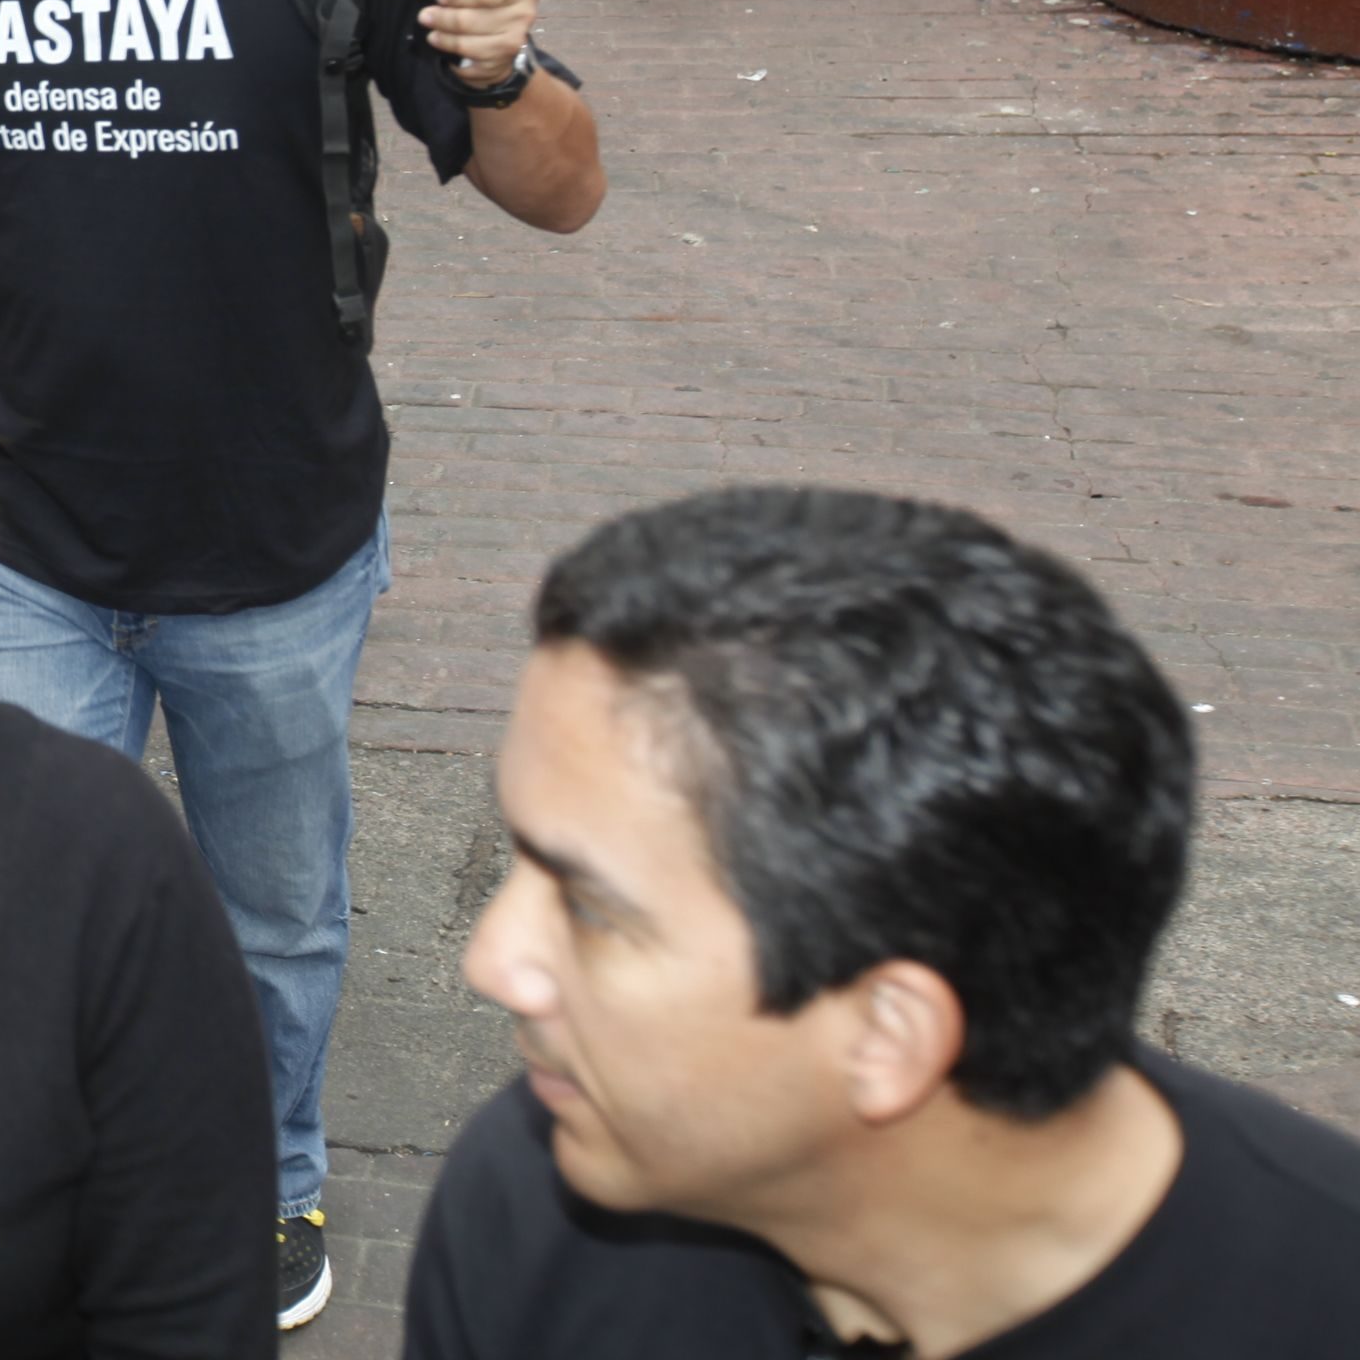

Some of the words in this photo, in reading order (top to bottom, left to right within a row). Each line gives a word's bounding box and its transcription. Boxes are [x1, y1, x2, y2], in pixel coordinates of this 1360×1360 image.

[4, 80, 118, 112] defensa
[125, 79, 161, 111] de
[53, 121, 87, 152] de
[95, 120, 239, 159] Expresión
